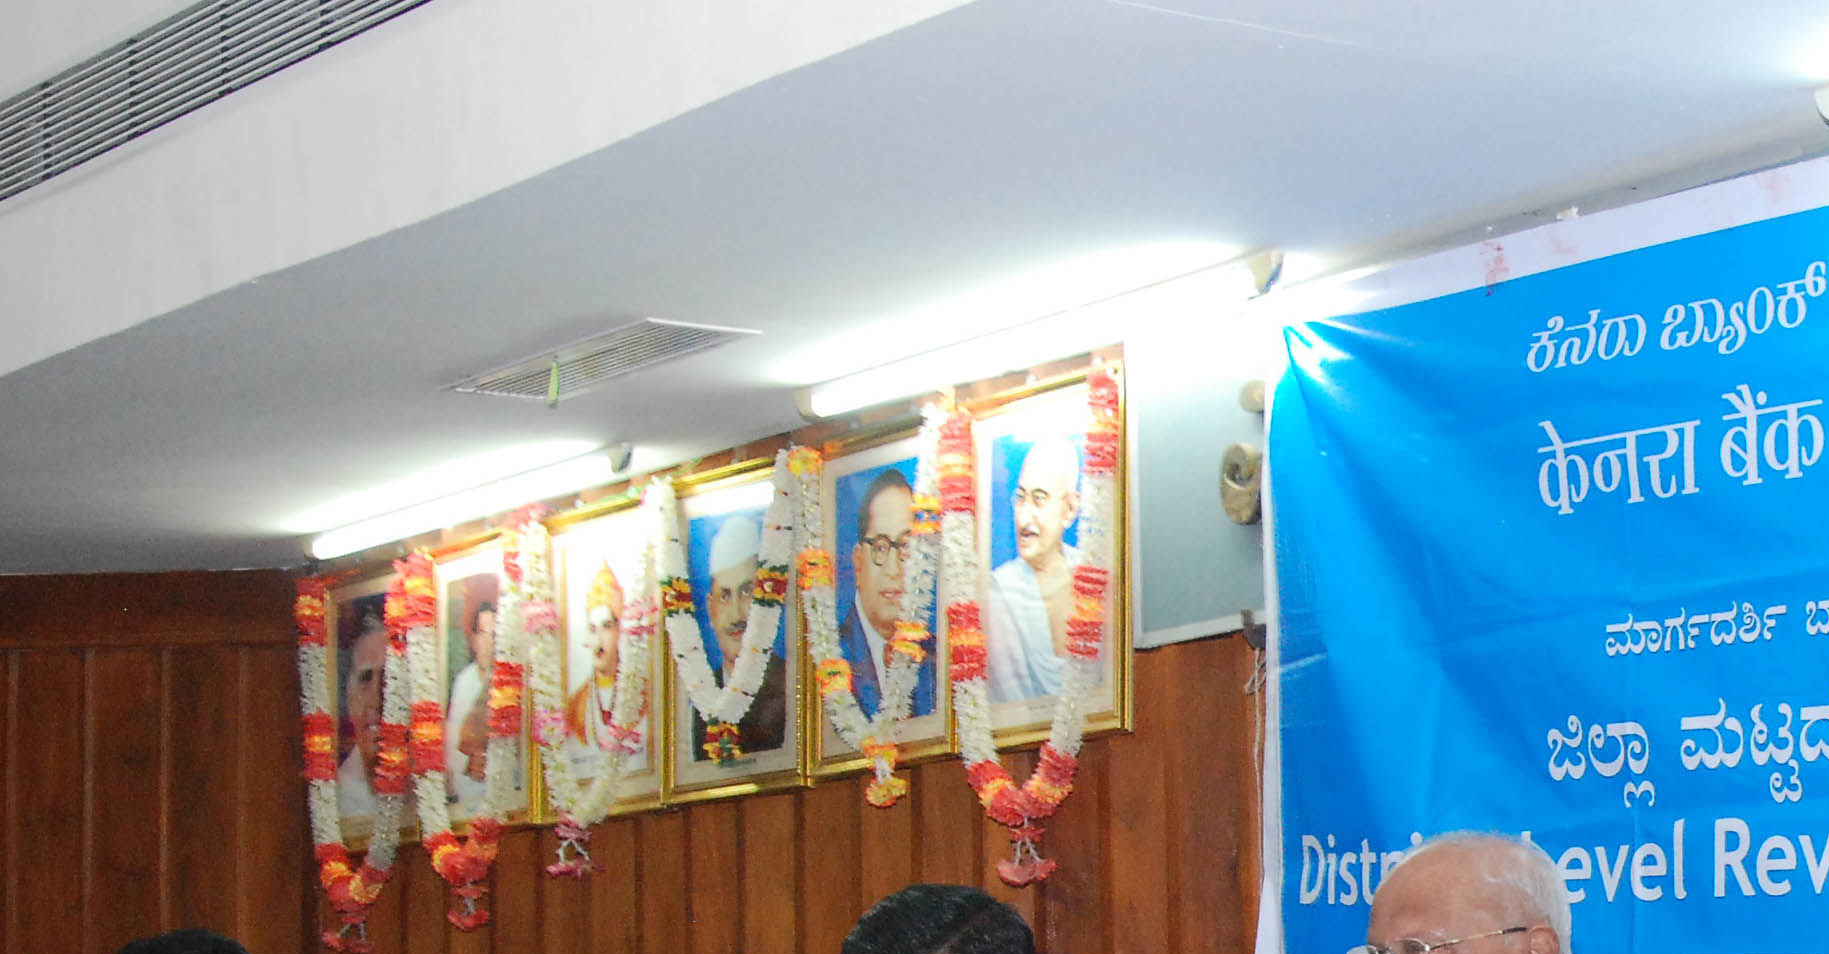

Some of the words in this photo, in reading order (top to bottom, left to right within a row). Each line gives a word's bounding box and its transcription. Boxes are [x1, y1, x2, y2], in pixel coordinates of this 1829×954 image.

[1526, 309, 1647, 373] ಕೆನರಾ
[1660, 261, 1827, 355] ಬ್ಯಾಂಕ್
[1538, 420, 1701, 515] केनरा
[1720, 383, 1824, 485] बैंक
[1605, 602, 1787, 657] ಮಾರ್ಗದರ್ಶಿ
[1546, 714, 1655, 809] ಜಿಲ್ಲಾ
[1520, 818, 1686, 904] evel
